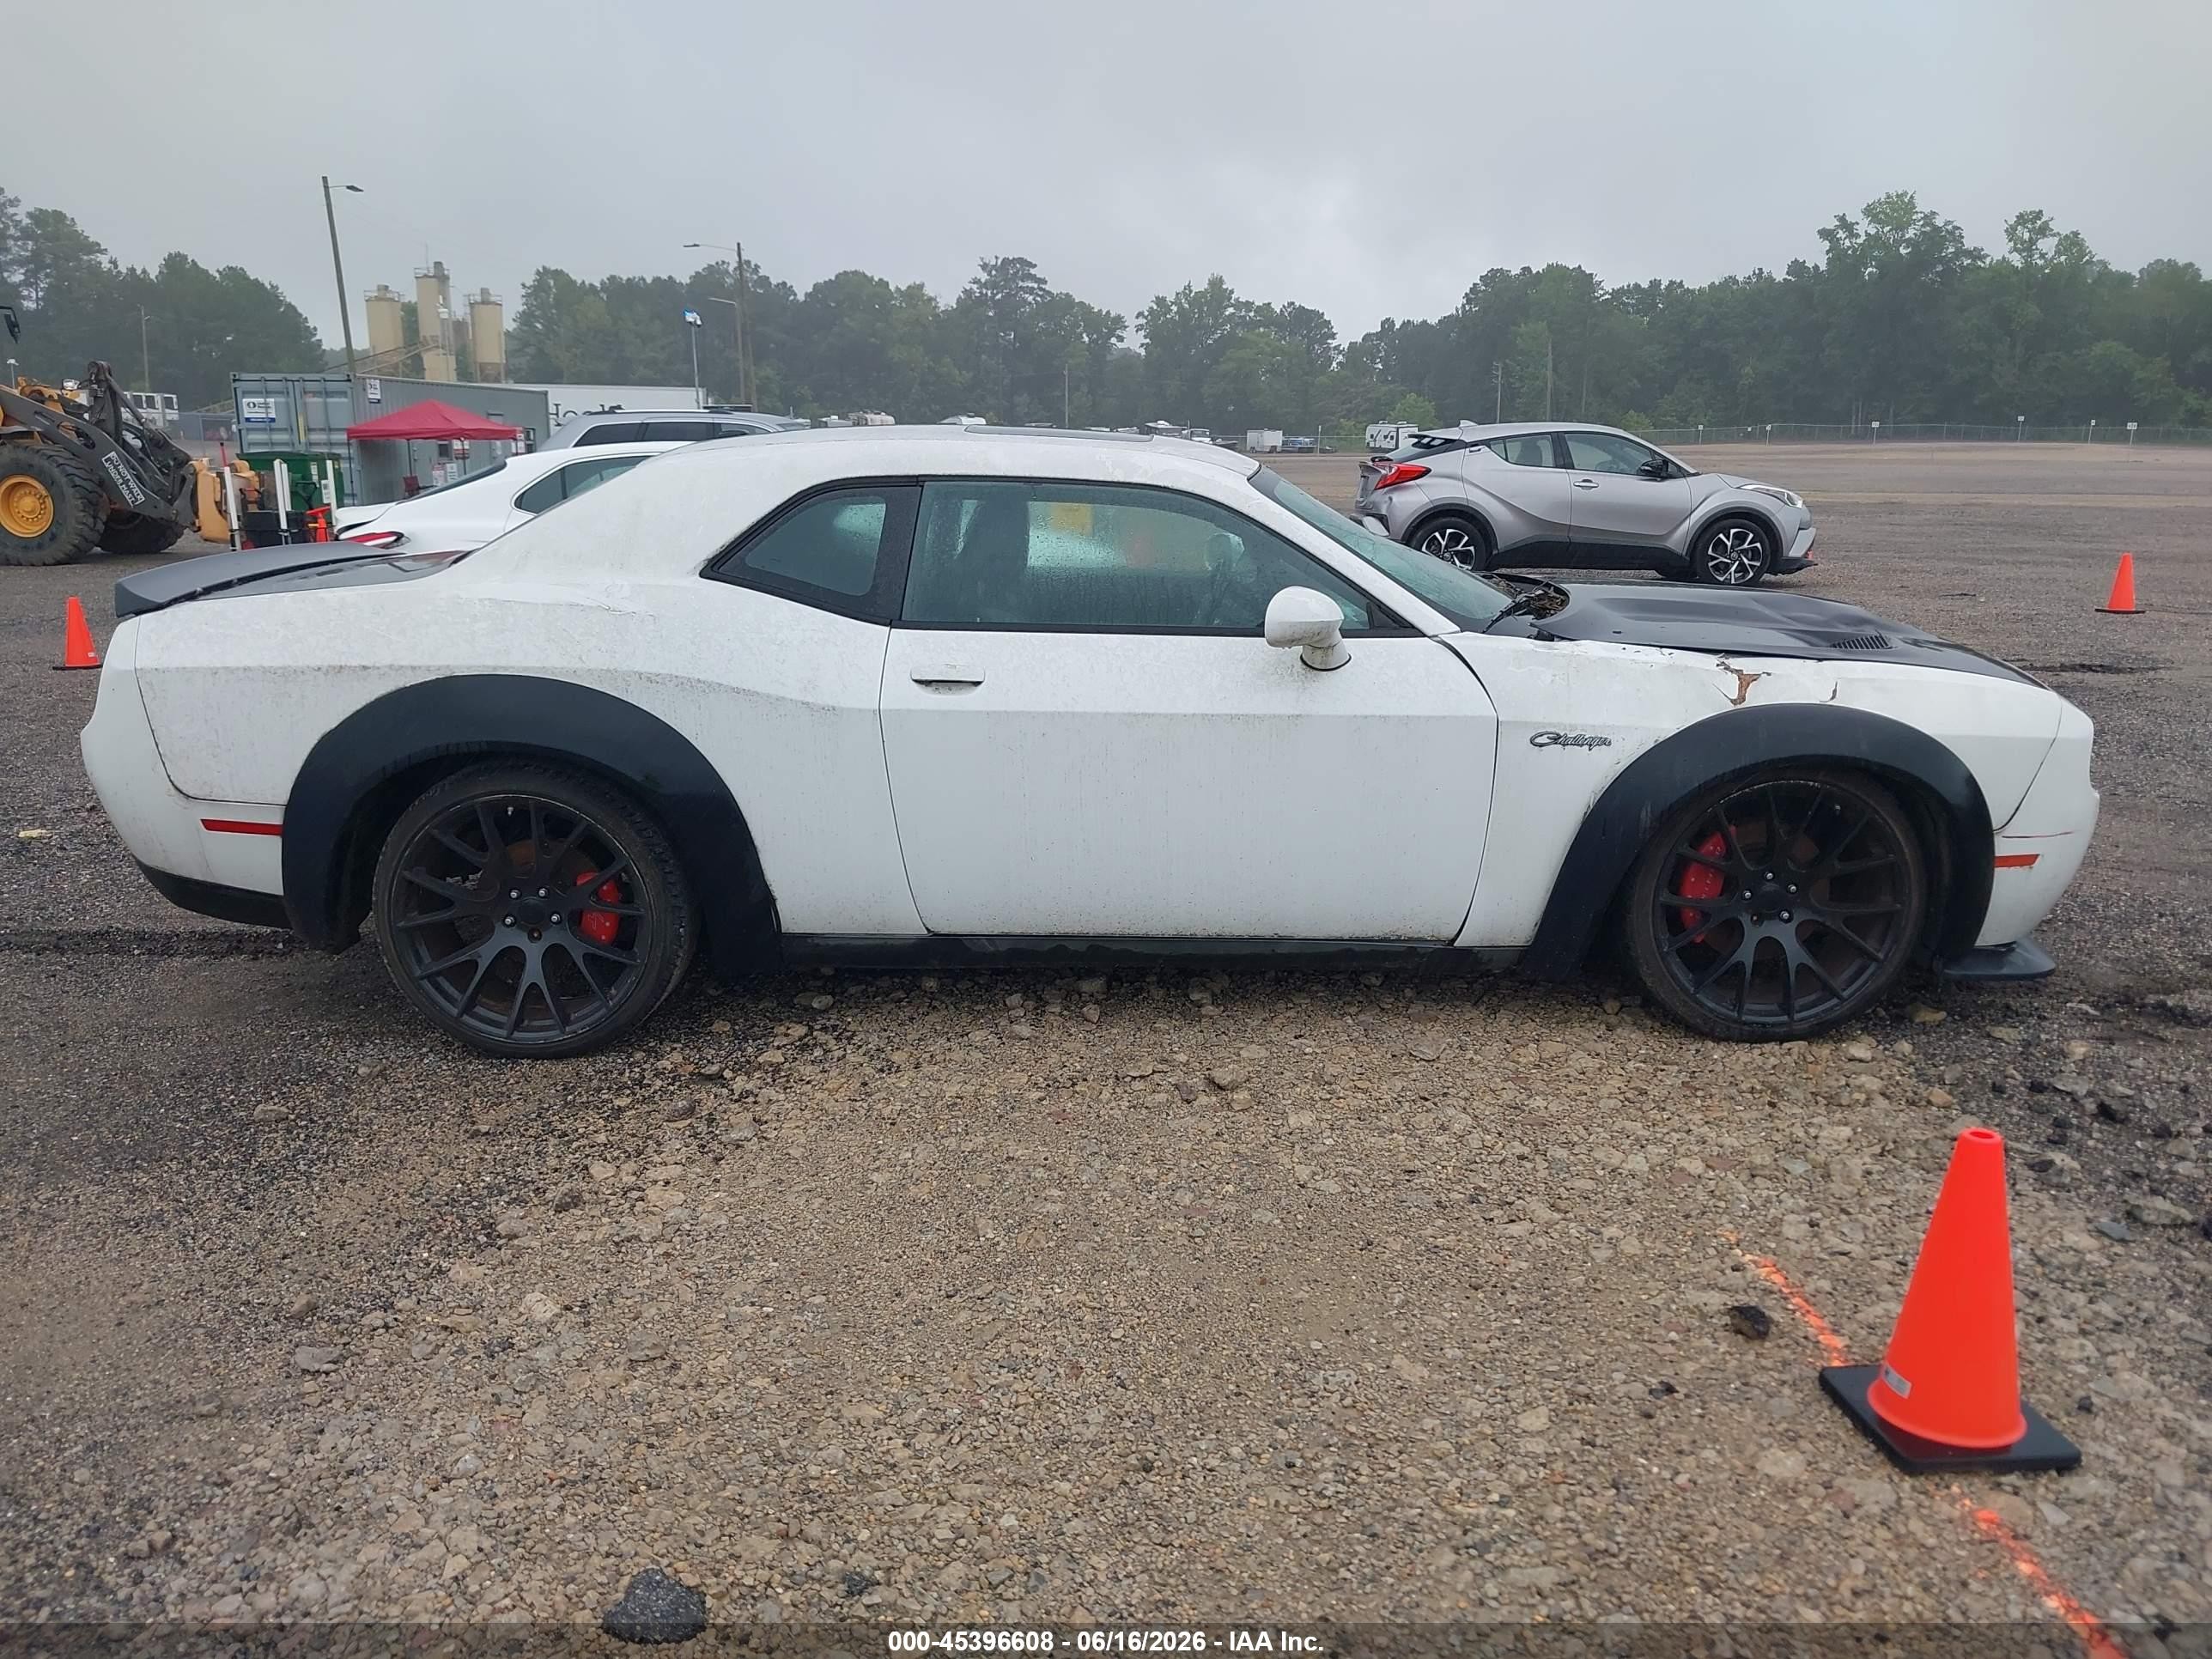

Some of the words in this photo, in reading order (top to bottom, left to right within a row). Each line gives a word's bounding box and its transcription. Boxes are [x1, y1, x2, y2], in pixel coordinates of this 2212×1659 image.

[105, 459, 124, 485] UNDER
[120, 484, 135, 502] MAST
[118, 465, 131, 481] NOT
[129, 481, 144, 501] WALK
[1529, 731, 1612, 751] Challenger
